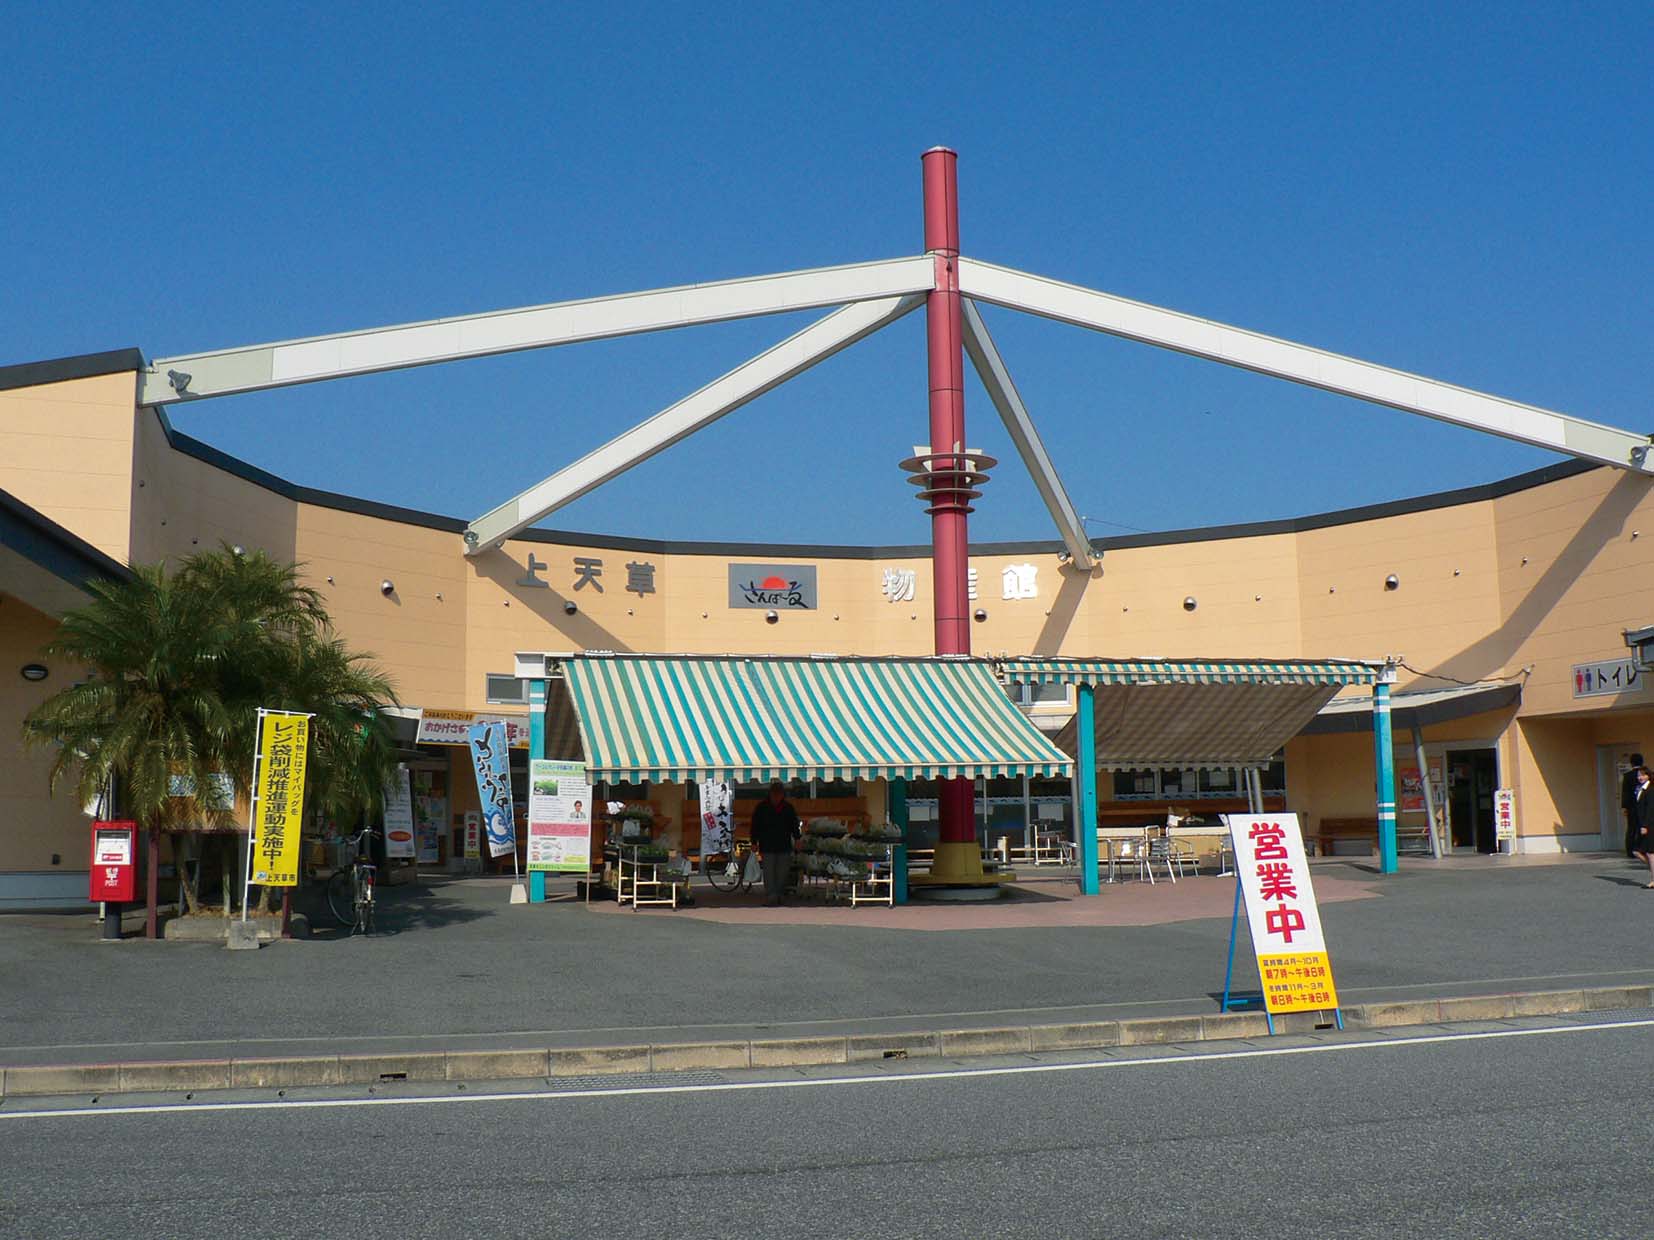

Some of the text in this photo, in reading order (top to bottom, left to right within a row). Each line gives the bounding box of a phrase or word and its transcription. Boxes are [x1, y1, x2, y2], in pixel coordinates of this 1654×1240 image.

[516, 553, 656, 598] 上天草
[1598, 664, 1636, 688] トイレ
[262, 722, 294, 870] レジ袋削減推進運動実施中！
[291, 720, 306, 815] お買い物にはマイバッグを
[1248, 822, 1306, 943] 営業中
